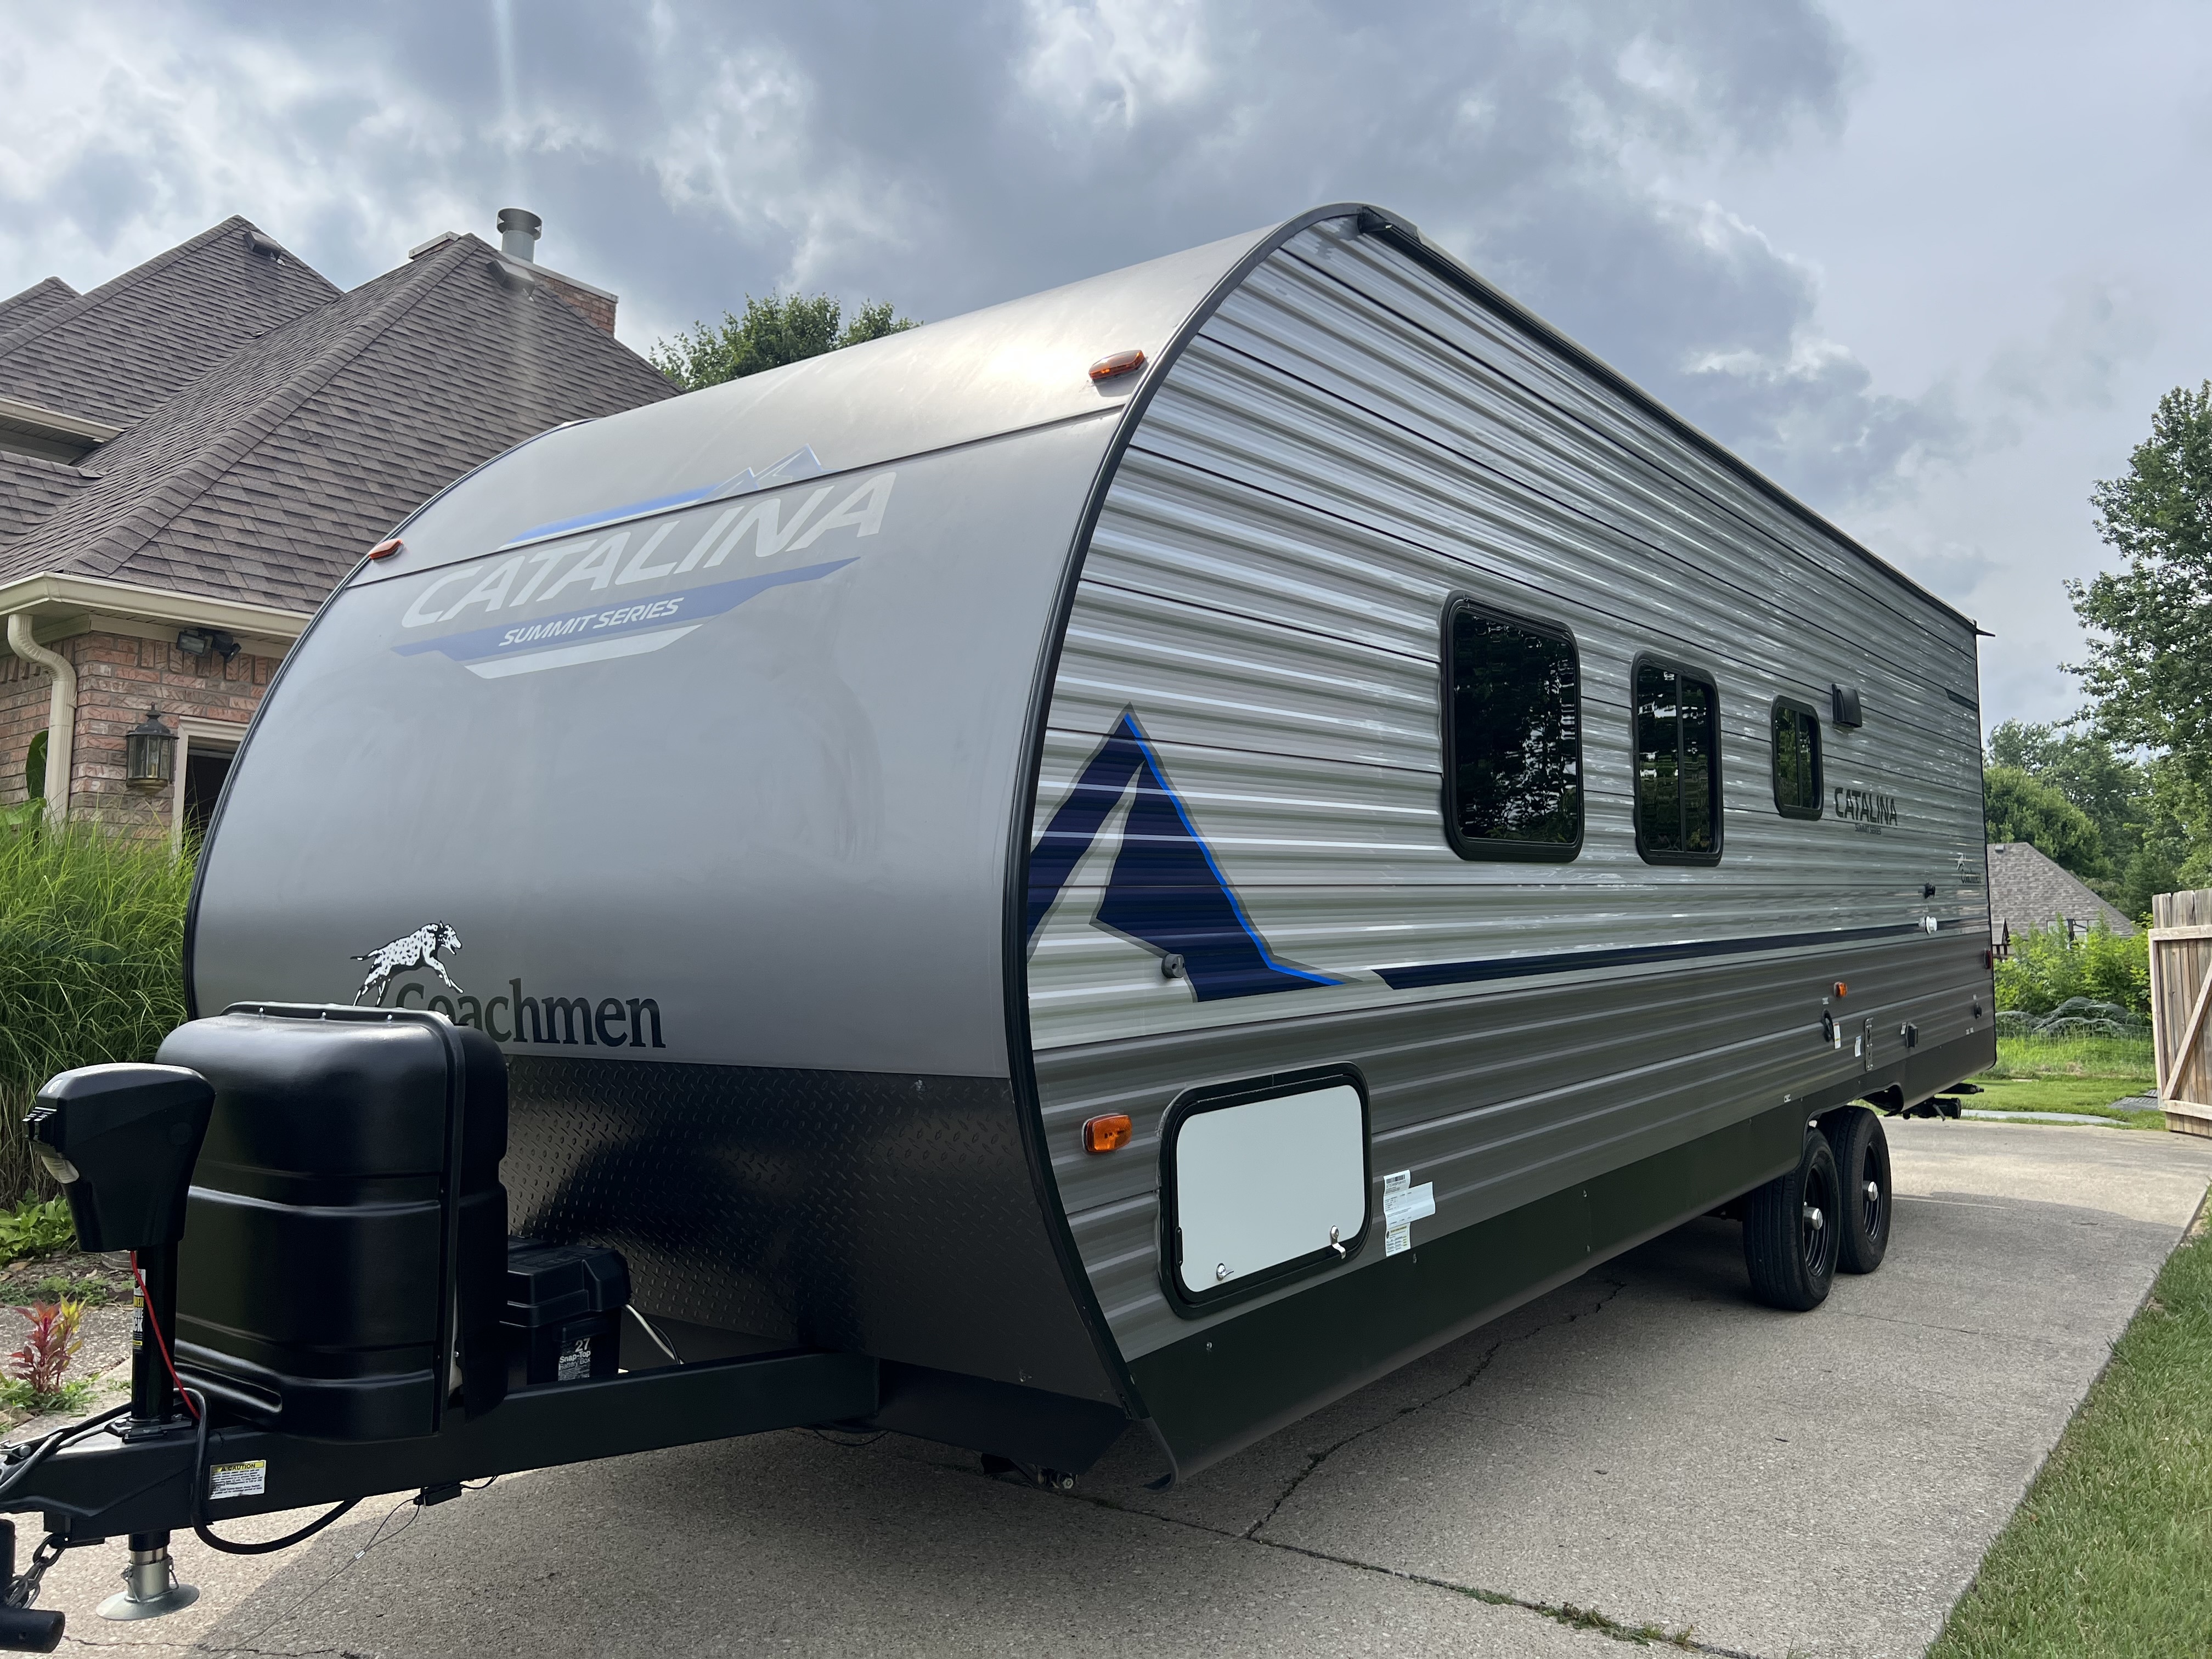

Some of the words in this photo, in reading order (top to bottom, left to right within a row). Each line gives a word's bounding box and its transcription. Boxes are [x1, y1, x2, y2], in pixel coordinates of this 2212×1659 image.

[402, 471, 897, 628] CATALINA
[498, 616, 596, 646] SUMMIT
[596, 597, 684, 628] SERIES
[1834, 787, 1898, 826] CATALINA
[560, 1350, 591, 1363] Snap-Top
[575, 1337, 590, 1352] 27
